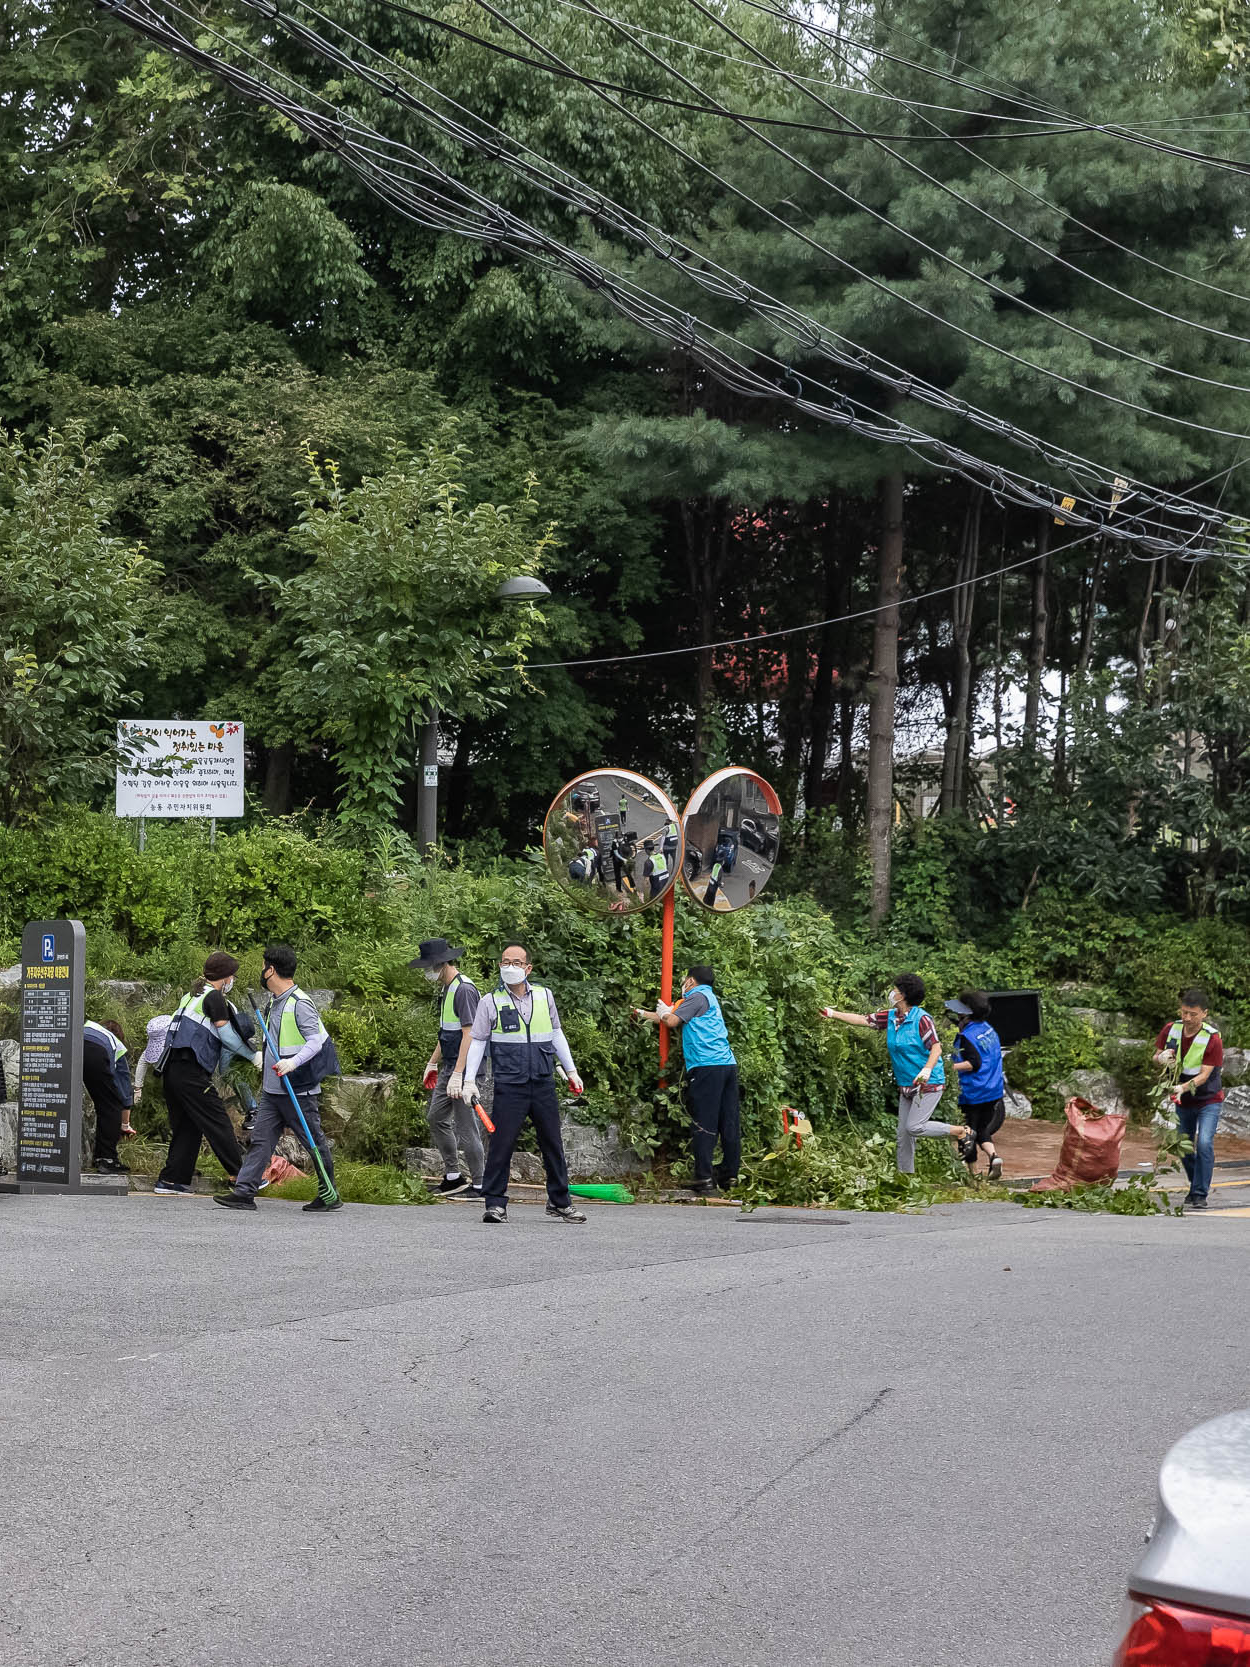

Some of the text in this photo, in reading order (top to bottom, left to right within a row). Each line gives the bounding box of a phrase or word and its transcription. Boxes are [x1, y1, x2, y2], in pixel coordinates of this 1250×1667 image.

[145, 727, 197, 739] 감이 익어가는
[172, 742, 225, 753] 정취있는 마을
[150, 803, 212, 812] 능동 주민자치위원회
